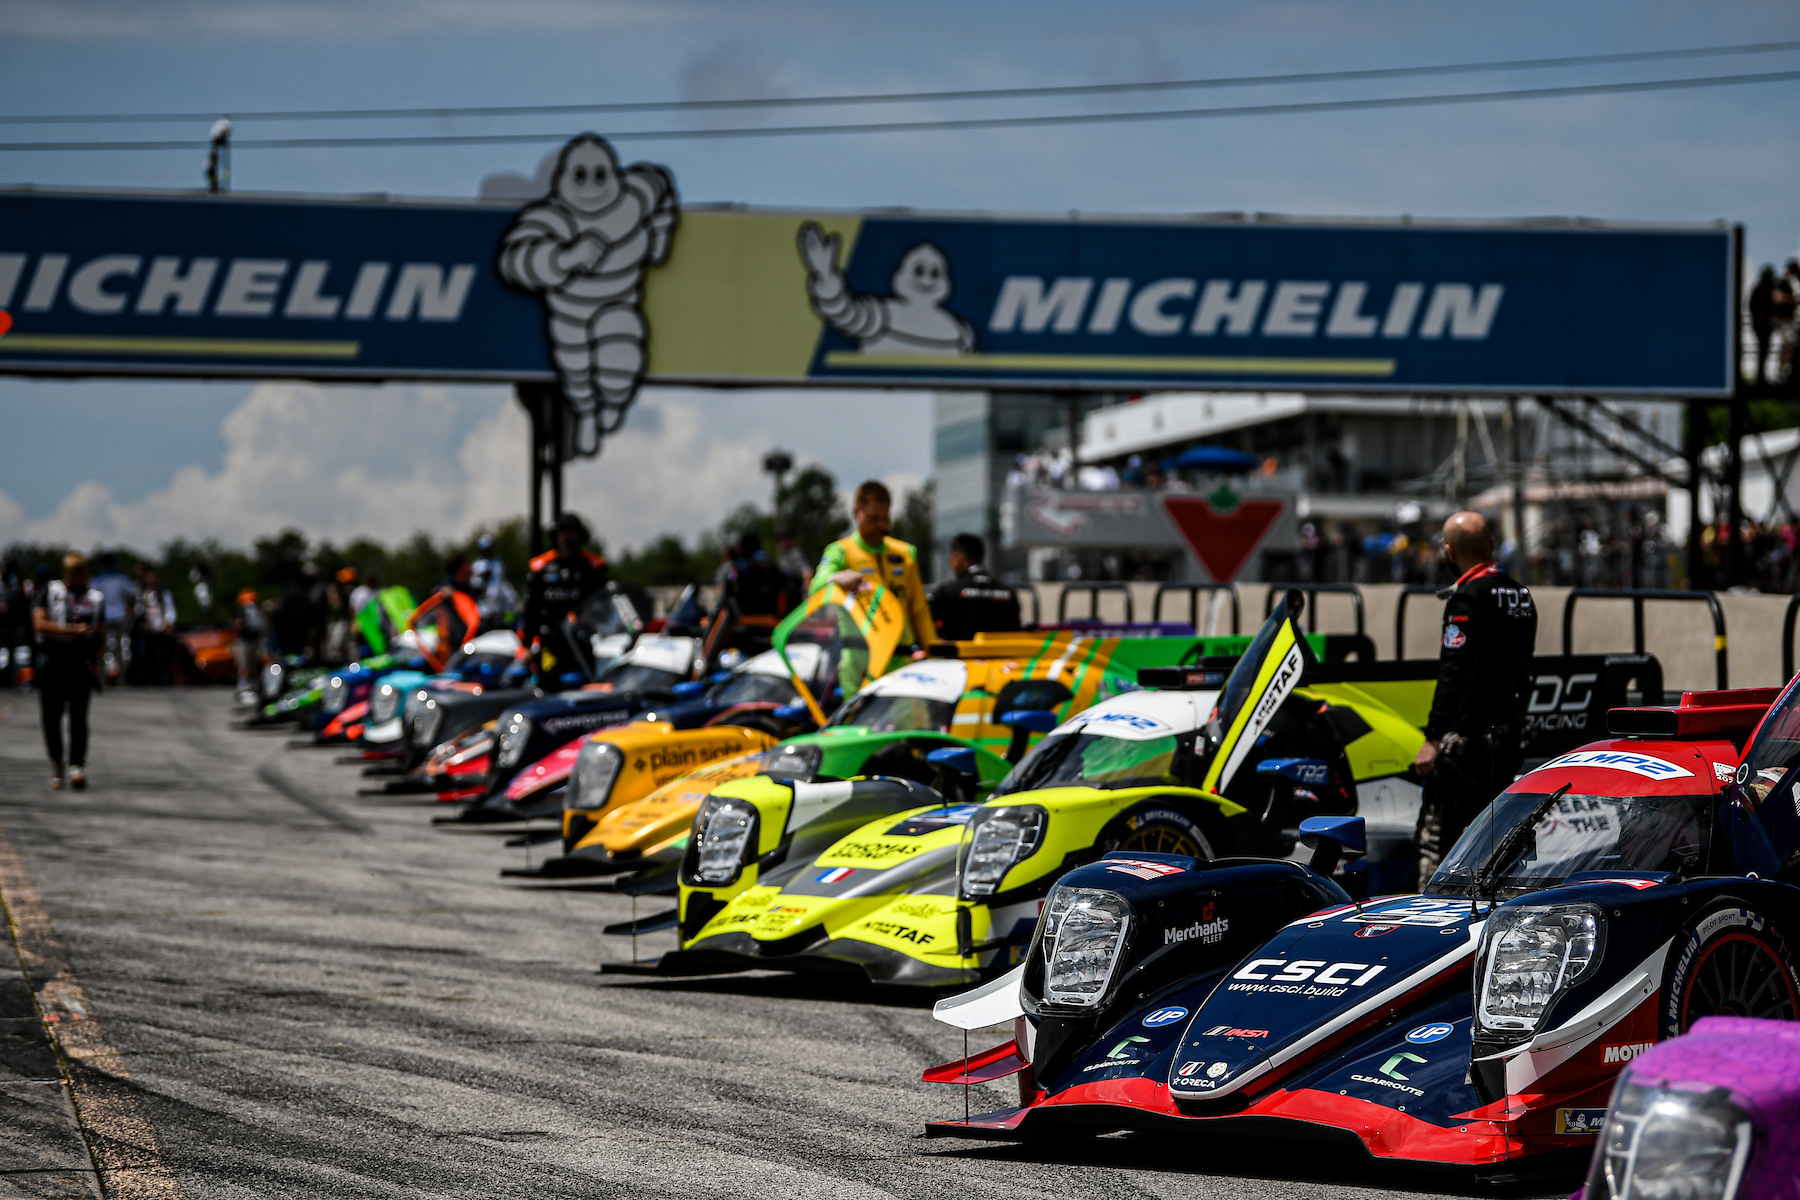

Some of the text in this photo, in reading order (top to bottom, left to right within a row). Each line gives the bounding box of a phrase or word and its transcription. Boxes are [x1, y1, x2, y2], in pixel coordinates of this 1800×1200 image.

[989, 276, 1503, 338] MICHELIN
[1491, 587, 1531, 607] TDS
[1272, 653, 1298, 694] TAF
[1528, 673, 1597, 712] DS
[651, 741, 742, 769] plain sight
[1558, 754, 1677, 774] LMP2
[1569, 815, 1610, 833] THE
[843, 842, 922, 855] THOMAS
[1165, 917, 1228, 944] Merchants
[1702, 914, 1735, 934] PILOT SPORT
[894, 926, 934, 944] TAF
[1203, 933, 1222, 945] FLEET
[1233, 959, 1387, 986] CSCI
[1669, 937, 1697, 1019] MICHELIN
[1228, 983, 1348, 997] www.csci.build
[1146, 1011, 1185, 1022] UP
[1223, 1028, 1269, 1038] IMSA
[1409, 1027, 1450, 1038] UP
[1083, 1060, 1140, 1072] CLEARROUTE
[1181, 1078, 1215, 1088] ORECA
[1351, 1075, 1424, 1096] CLEARROUTE
